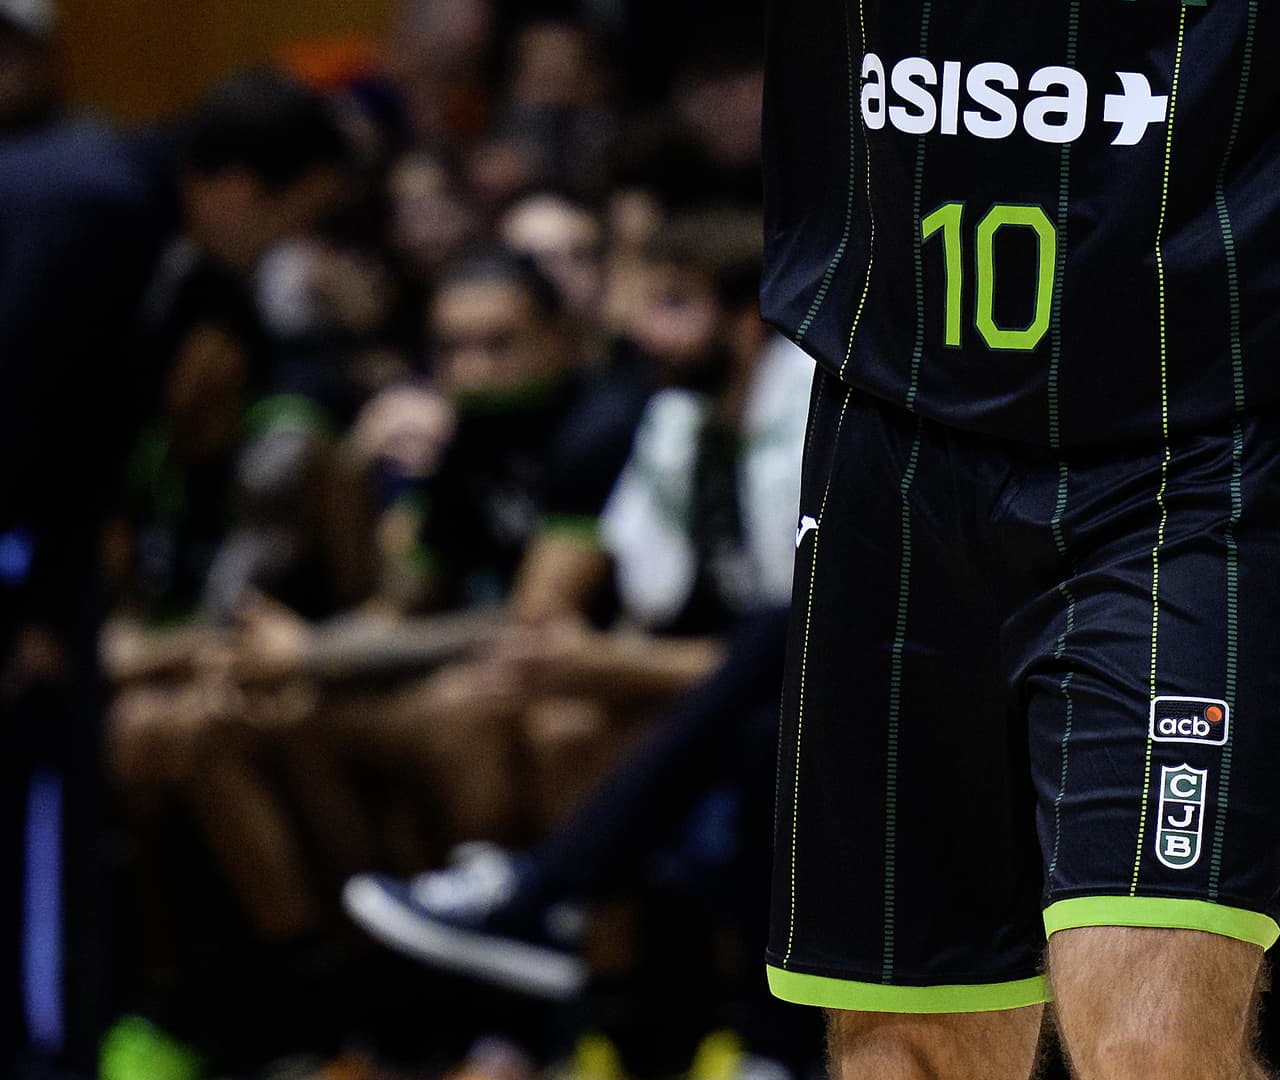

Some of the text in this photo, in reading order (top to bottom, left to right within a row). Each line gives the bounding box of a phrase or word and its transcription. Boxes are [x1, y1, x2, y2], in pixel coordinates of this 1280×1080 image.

[859, 53, 1088, 144] asisa
[920, 201, 1059, 351] 10
[1158, 716, 1210, 737] acb
